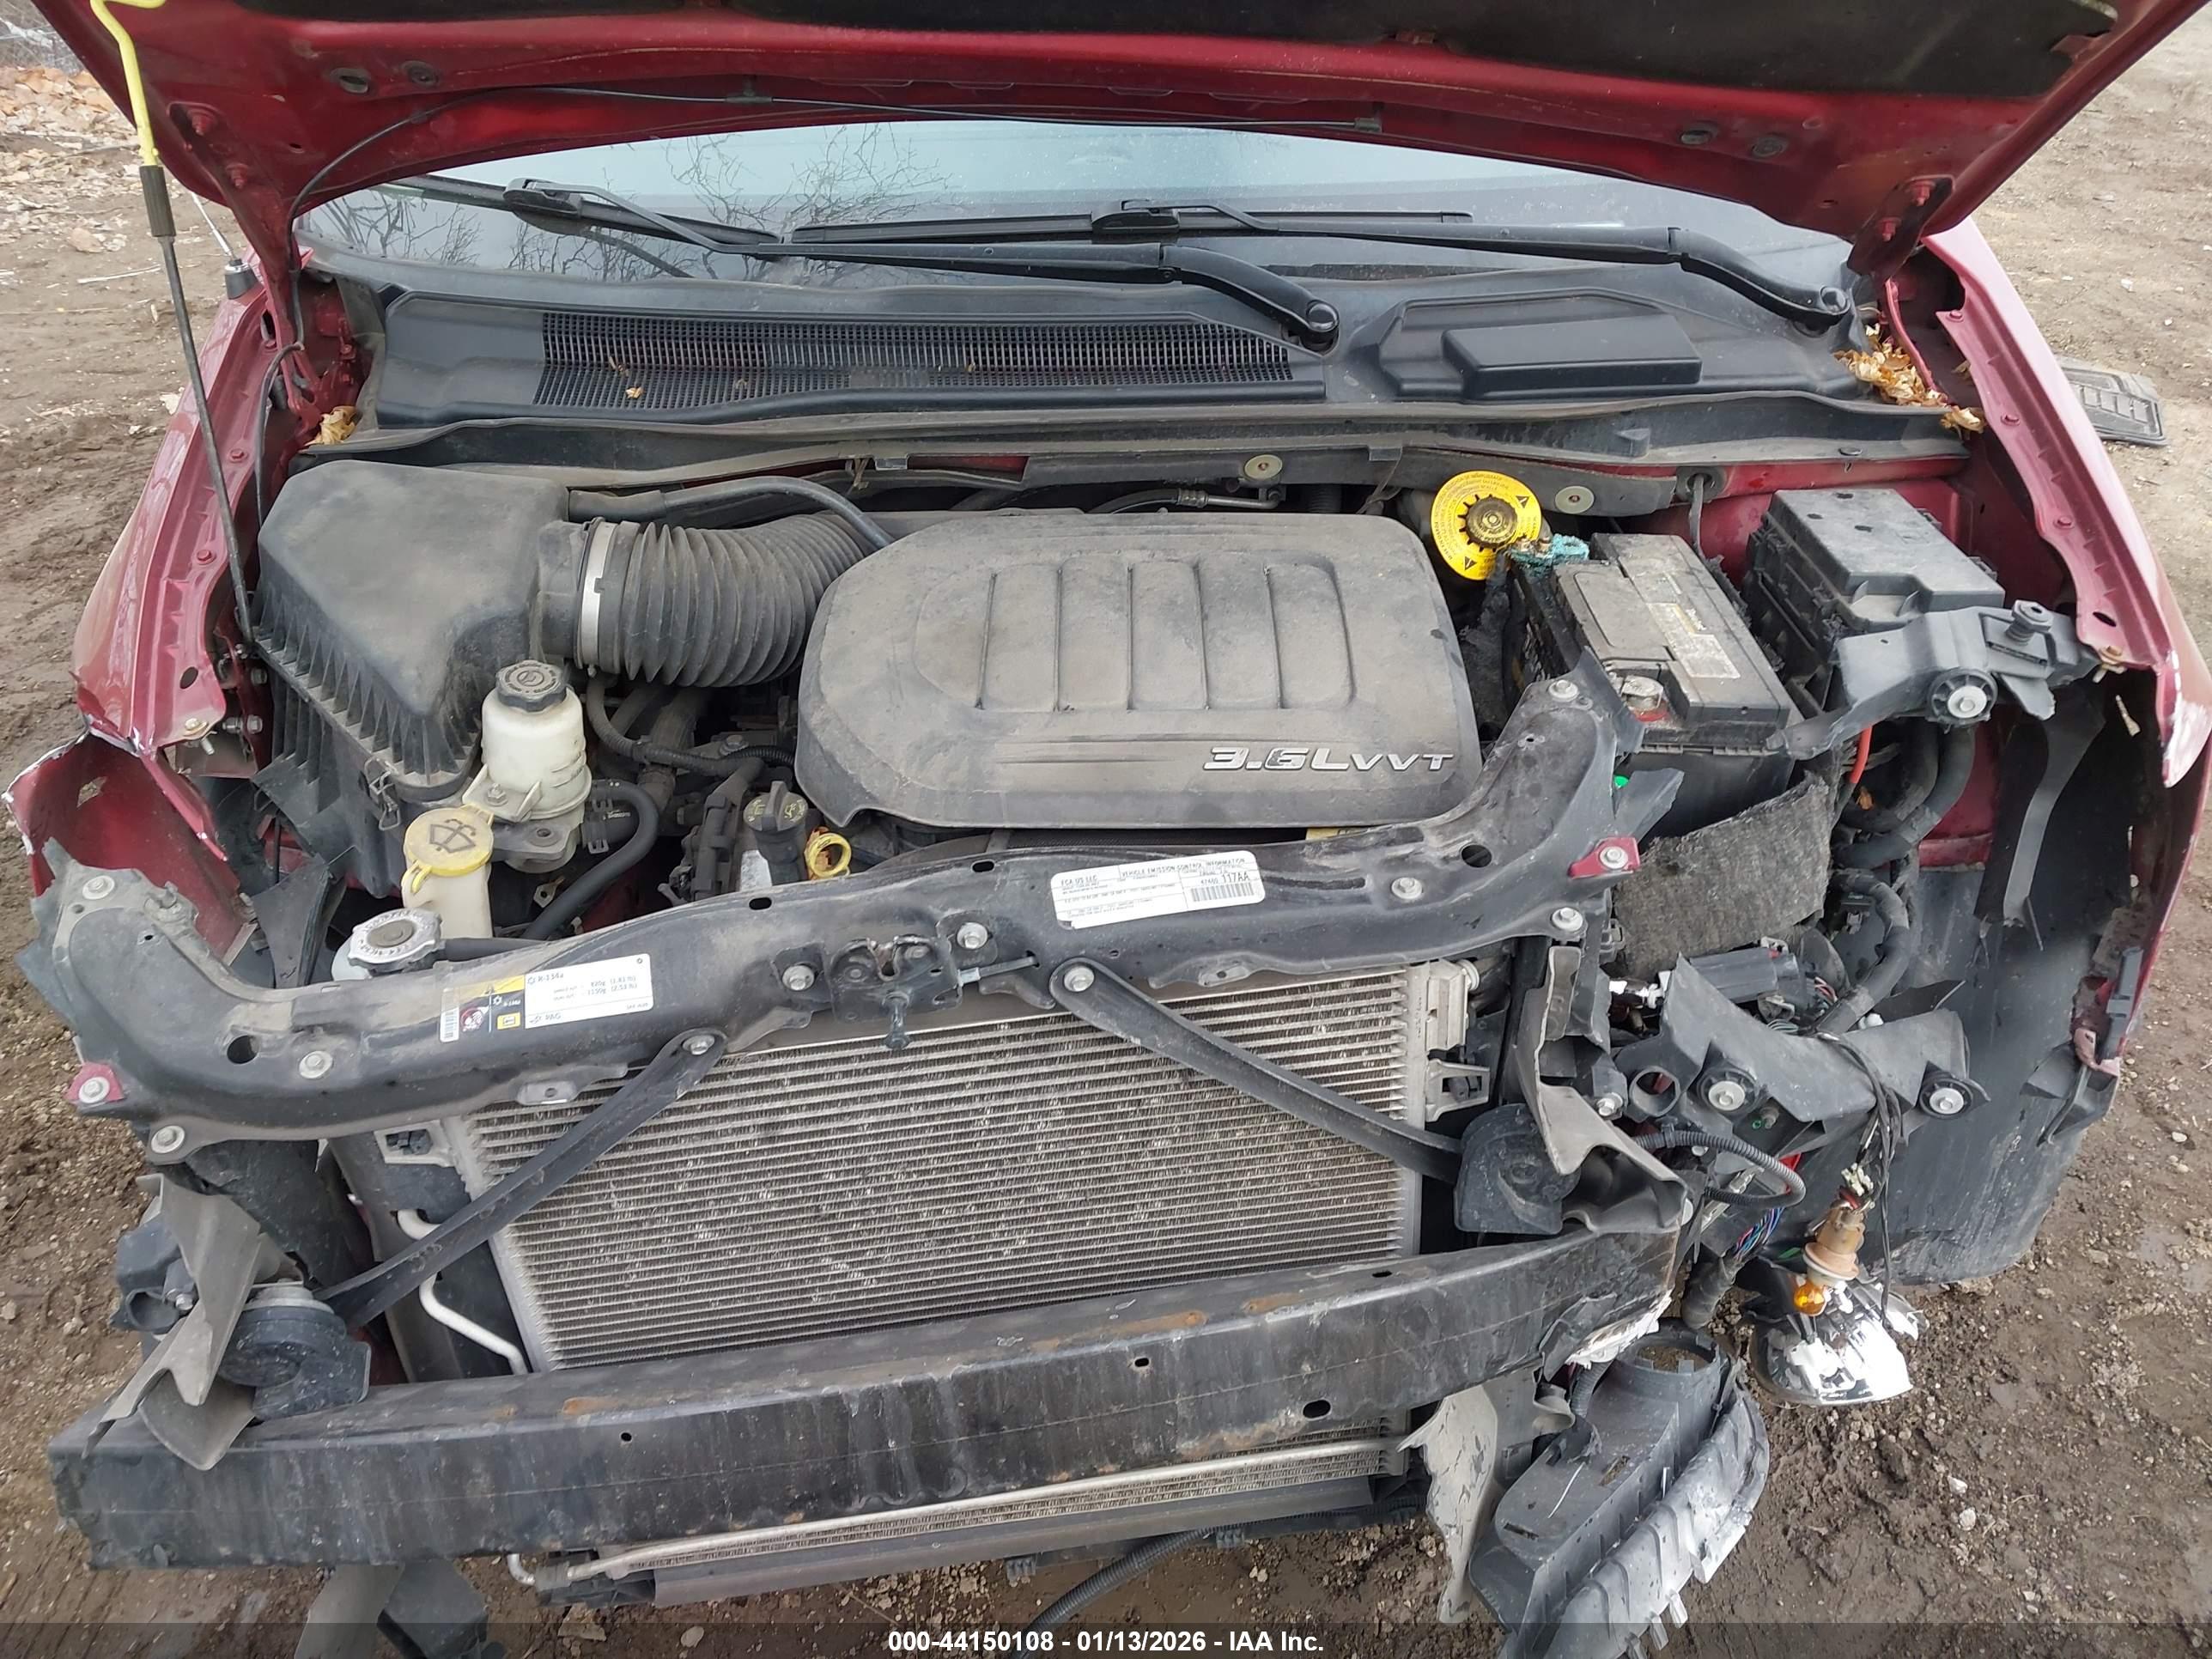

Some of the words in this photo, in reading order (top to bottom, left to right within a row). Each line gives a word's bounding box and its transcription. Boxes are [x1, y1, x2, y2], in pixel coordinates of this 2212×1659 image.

[1121, 868, 1145, 877] VEHICLE
[1147, 865, 1176, 873] EMISSION
[1222, 872, 1250, 883] 117AA
[538, 972, 564, 982] R-134a
